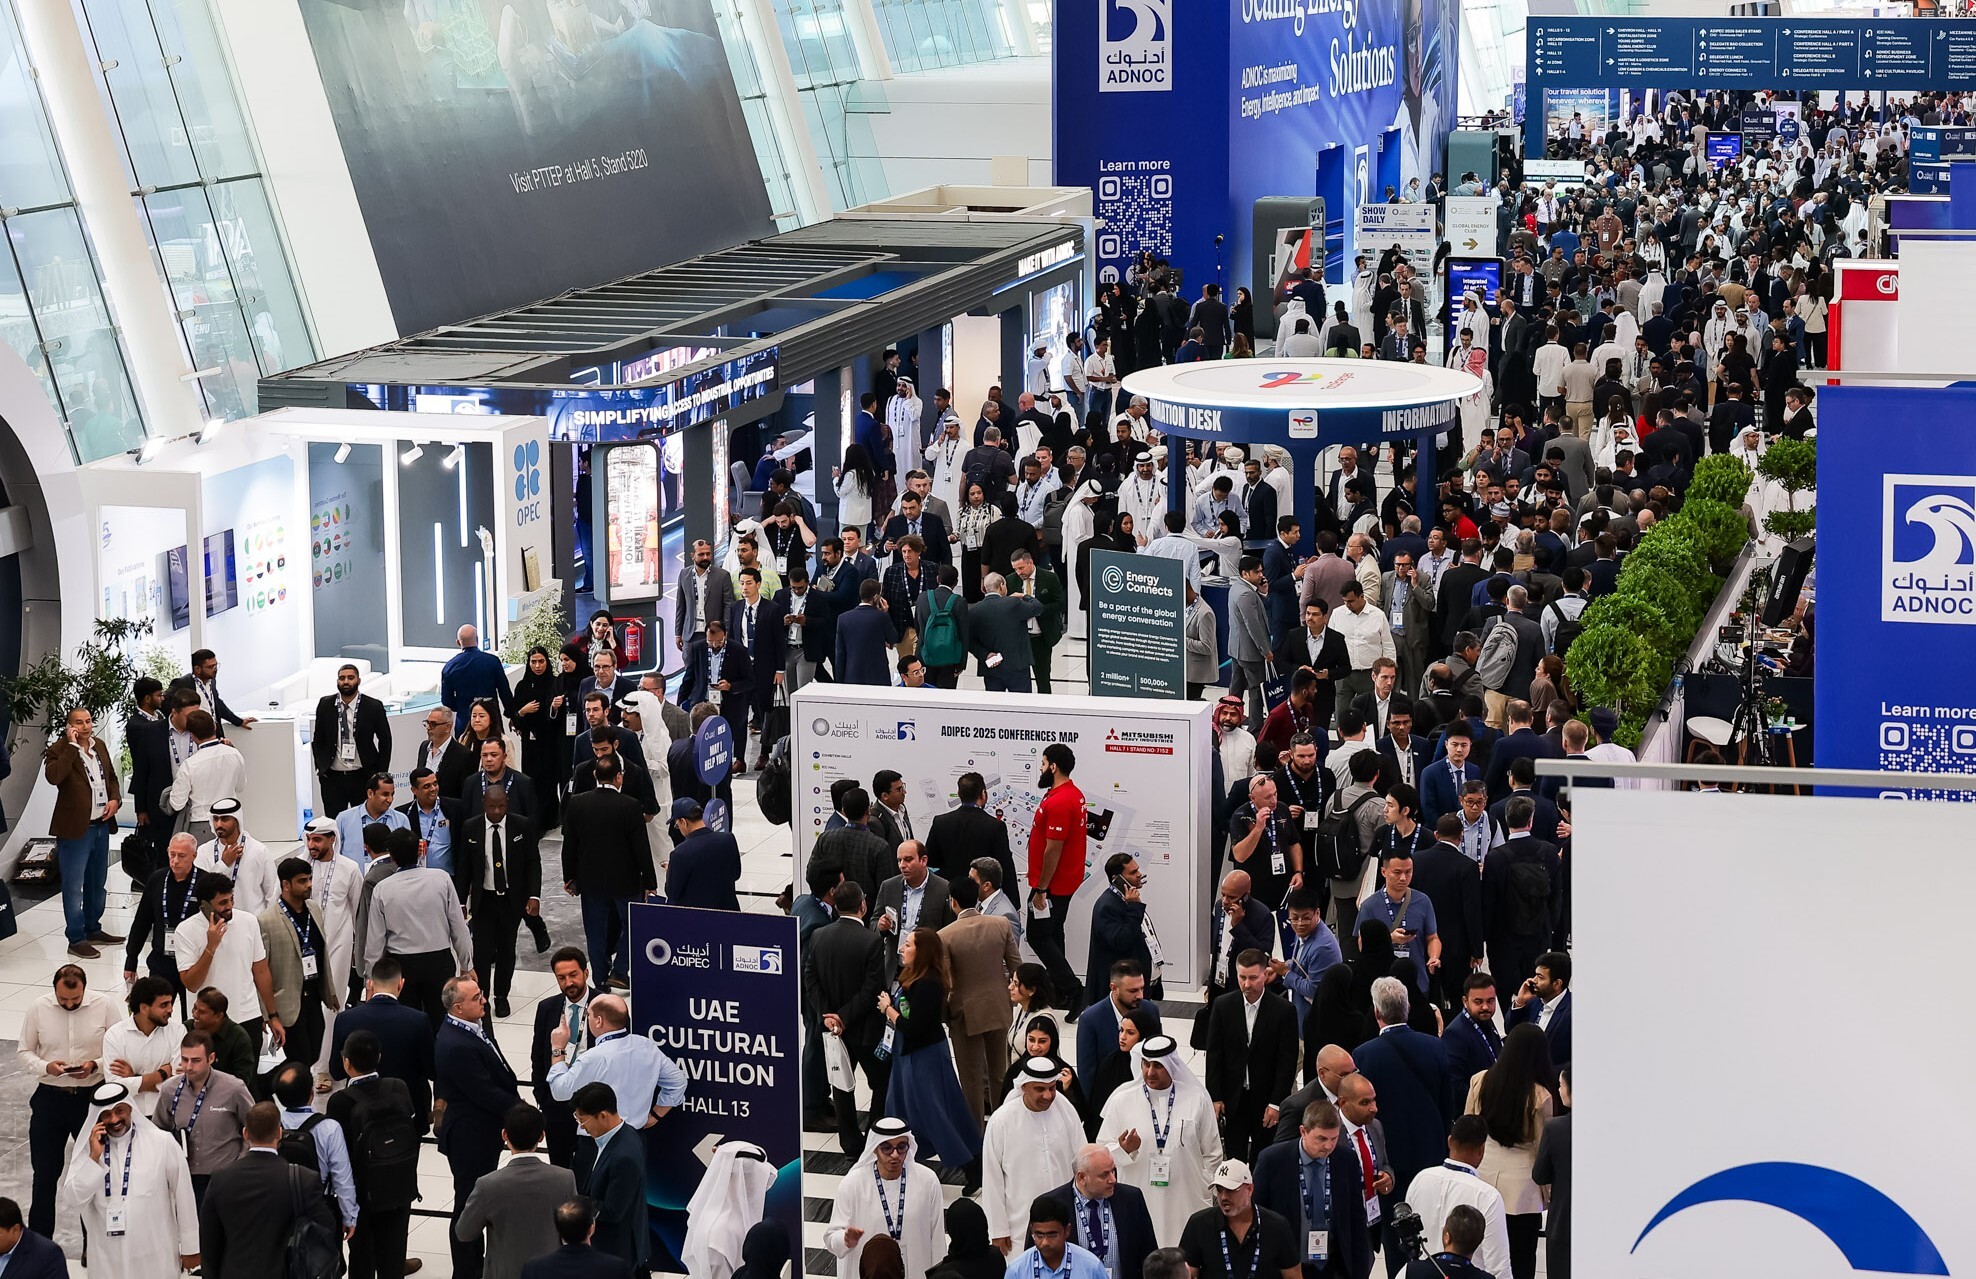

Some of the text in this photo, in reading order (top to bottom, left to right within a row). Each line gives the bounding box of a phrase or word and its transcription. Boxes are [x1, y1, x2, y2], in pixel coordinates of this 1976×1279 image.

[1329, 31, 1395, 98] Solutions
[1107, 69, 1164, 83] ADNOC
[1241, 65, 1263, 90] ADNOC
[1268, 60, 1298, 84] maximizing
[1293, 85, 1303, 106] and
[1303, 83, 1320, 107] Impact
[509, 148, 649, 193] Visit PTTEP at Hall 5, Stand 5220
[1100, 160, 1171, 171] Learn more
[1362, 207, 1386, 215] SHOW
[1363, 215, 1385, 224] DAILY
[1041, 247, 1055, 269] WITH
[1055, 240, 1075, 263] ADNOC
[195, 324, 210, 334] ENU
[573, 404, 668, 426] SIMPLIFYING
[692, 395, 701, 408] TO
[701, 383, 733, 405] INDUSTRIAL
[733, 366, 774, 393] OPPORTUNITIES
[1189, 407, 1222, 432] DESK
[1382, 401, 1451, 433] INFORMATION
[517, 501, 541, 527] OPEC
[1126, 571, 1159, 586] Energy
[1126, 582, 1173, 597] Connects
[1099, 601, 1108, 609] Be
[1116, 604, 1131, 612] part
[1141, 607, 1153, 615] the
[1154, 609, 1176, 618] global
[1892, 596, 1973, 614] ADNOC
[1102, 612, 1173, 627] energy conversation
[1105, 672, 1130, 681] million+
[1140, 677, 1168, 687] 500,000+
[1881, 701, 1976, 720] Learn more
[831, 730, 860, 739] ADIPEC
[941, 725, 1079, 744] ADIPEC 2025 CONFERENCES MAP
[1121, 731, 1173, 740] MITSUBISHI
[709, 742, 719, 757] MAY
[704, 751, 727, 772] HELP YOU?
[671, 956, 710, 968] ADIPEC
[689, 997, 739, 1023] UAE
[648, 1024, 784, 1058] CULTURAL
[674, 1057, 774, 1087] AVILION
[682, 1096, 750, 1118] HALL 13
